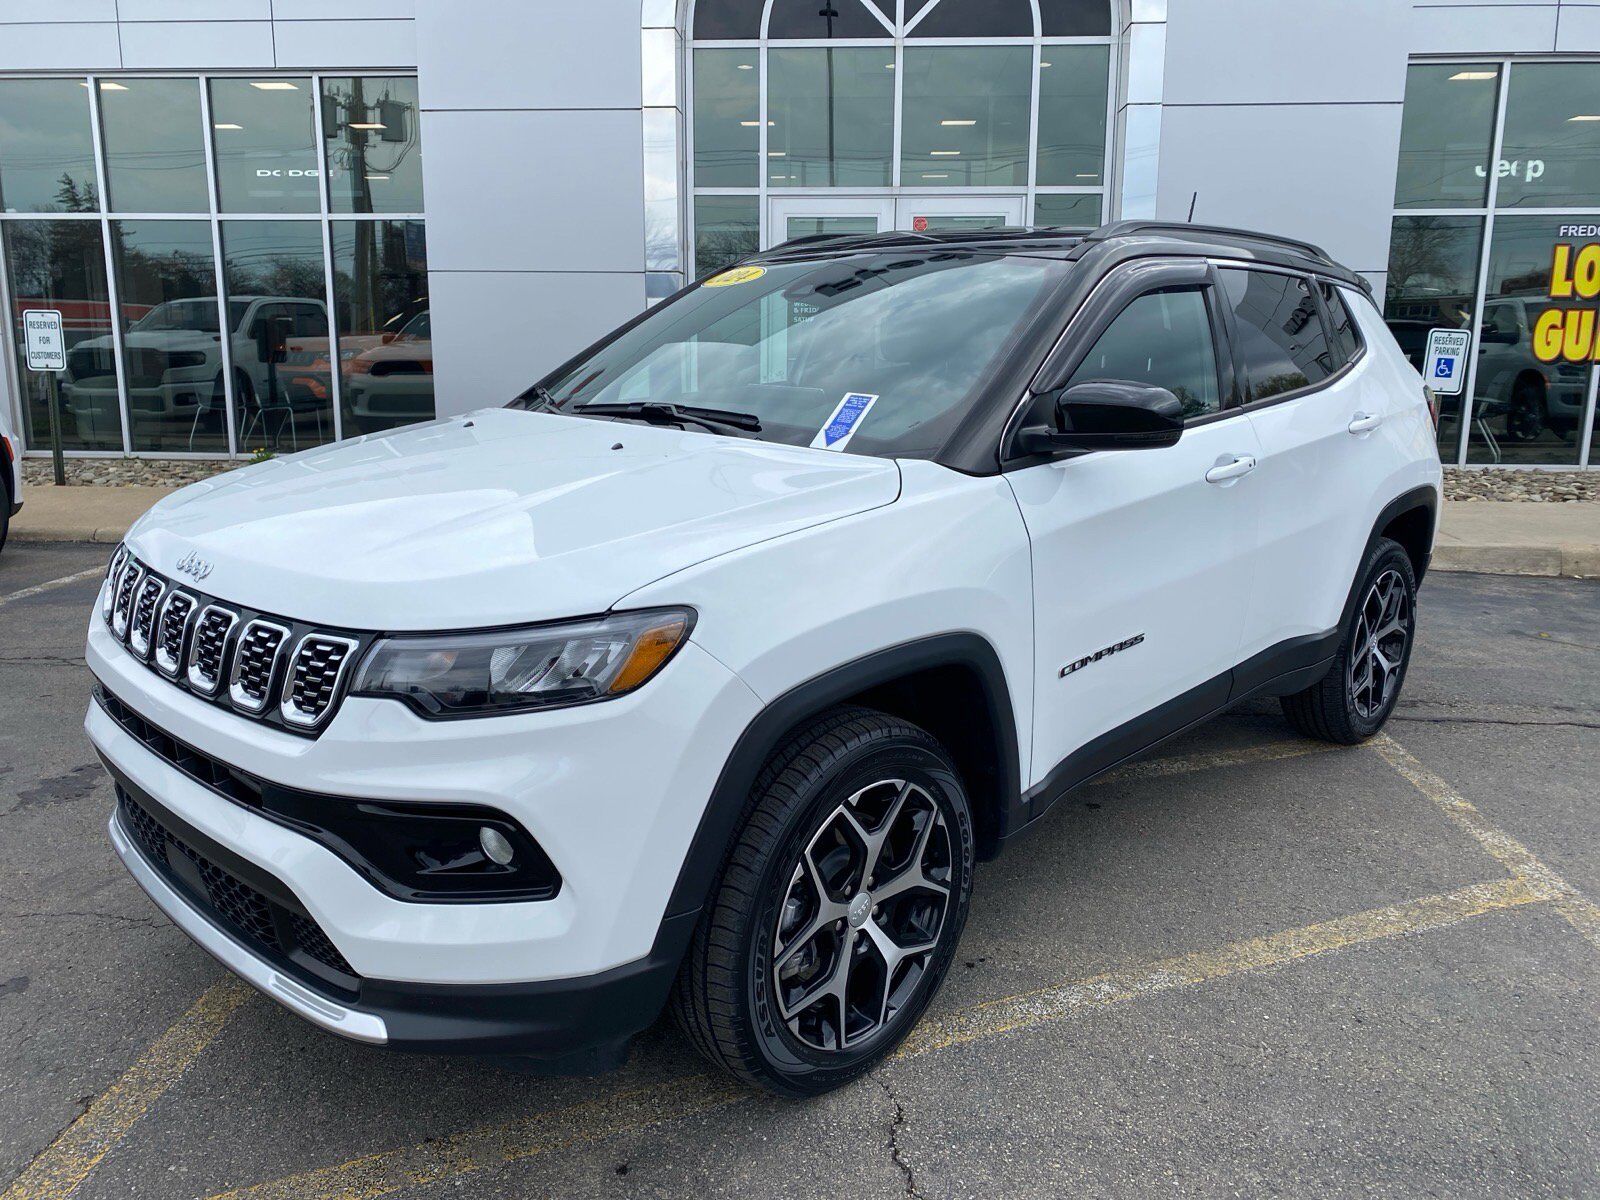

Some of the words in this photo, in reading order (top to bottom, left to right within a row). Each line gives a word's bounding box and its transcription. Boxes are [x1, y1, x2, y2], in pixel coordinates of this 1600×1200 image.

[256, 169, 334, 177] DODG
[1560, 225, 1600, 236] FRED
[28, 320, 58, 330] RESERVED
[1533, 309, 1600, 361] GU
[38, 336, 51, 345] FOR
[1433, 336, 1465, 346] RESERVED
[30, 351, 62, 360] CUSTOMERS
[1434, 346, 1461, 356] PARKING
[176, 550, 215, 583] Jeep
[1059, 632, 1145, 678] COMPASS
